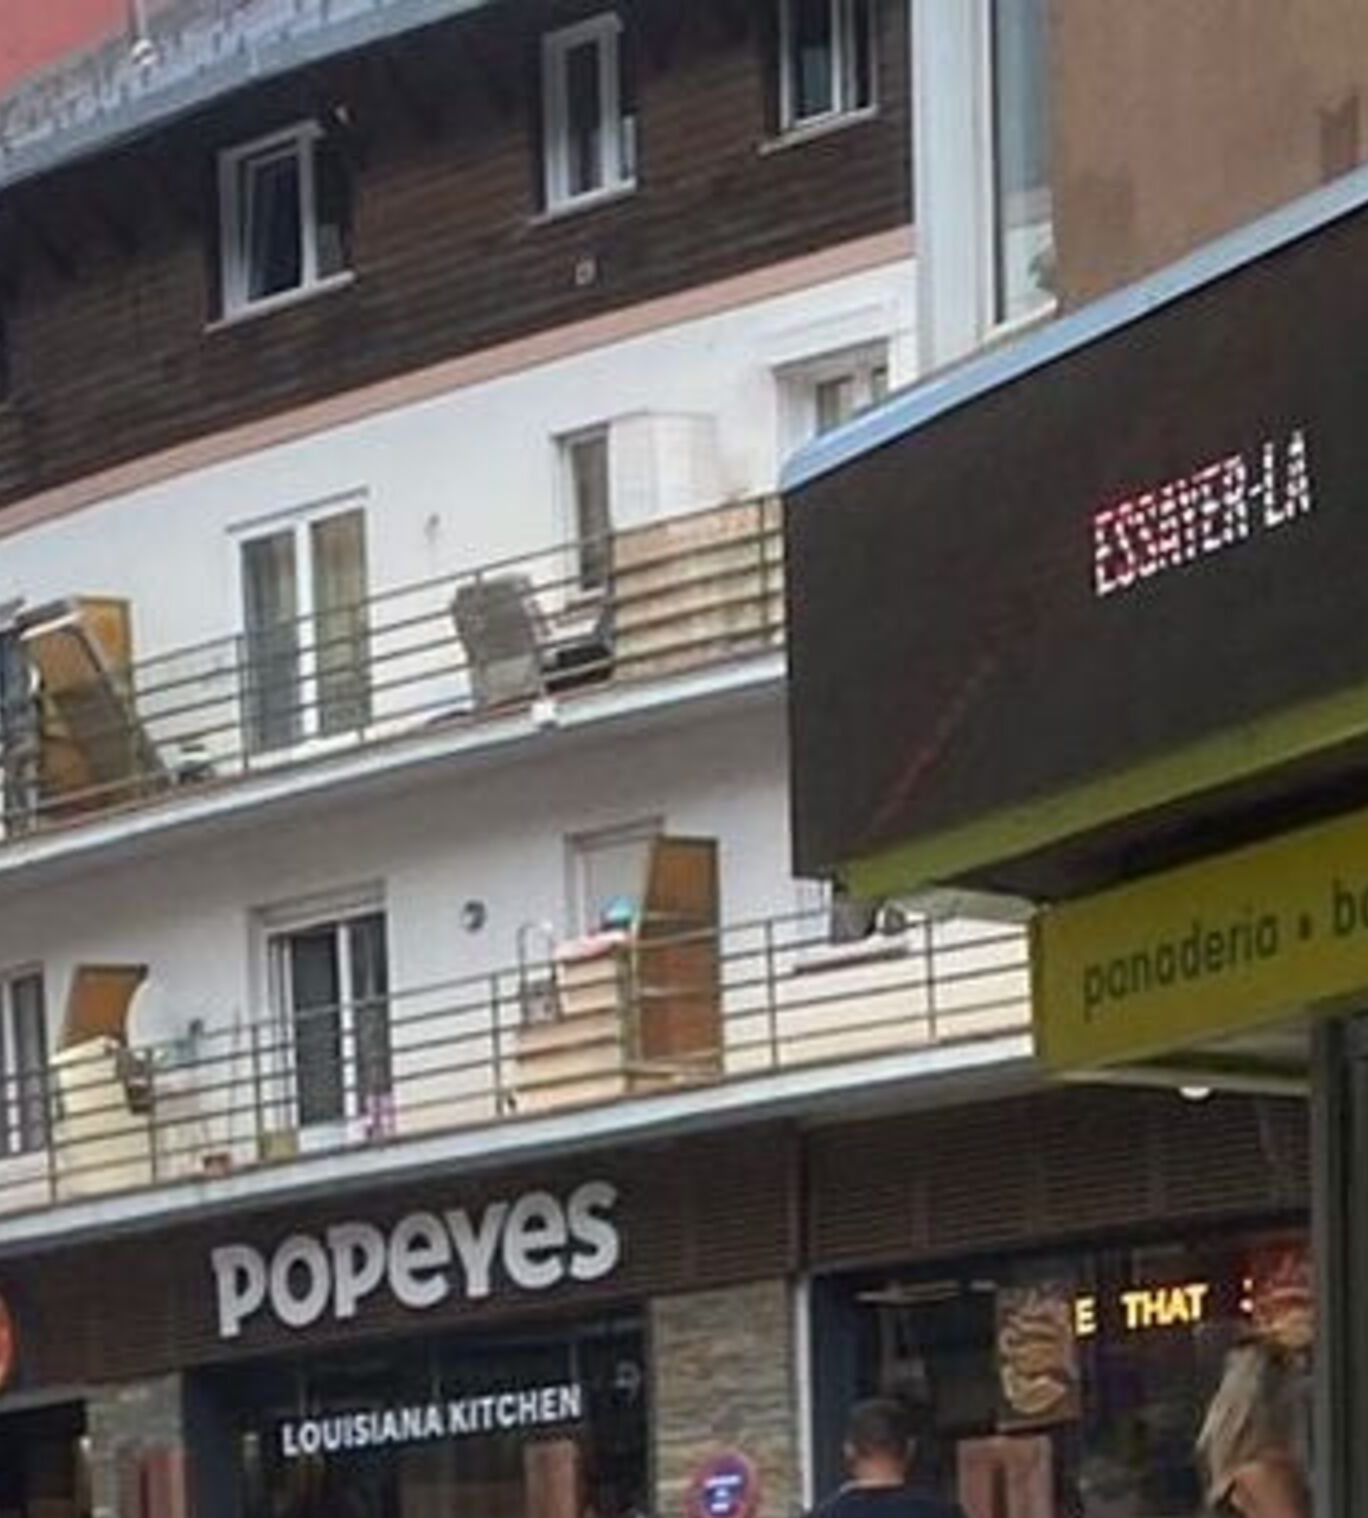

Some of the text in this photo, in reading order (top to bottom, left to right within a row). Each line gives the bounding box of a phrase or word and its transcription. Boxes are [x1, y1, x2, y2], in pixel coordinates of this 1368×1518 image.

[1095, 430, 1310, 596] ESSAYER-LA
[1082, 909, 1280, 1021] panaderia
[1121, 1282, 1209, 1329] THAT
[282, 1383, 582, 1458] LOUISIANA KITCHEN
